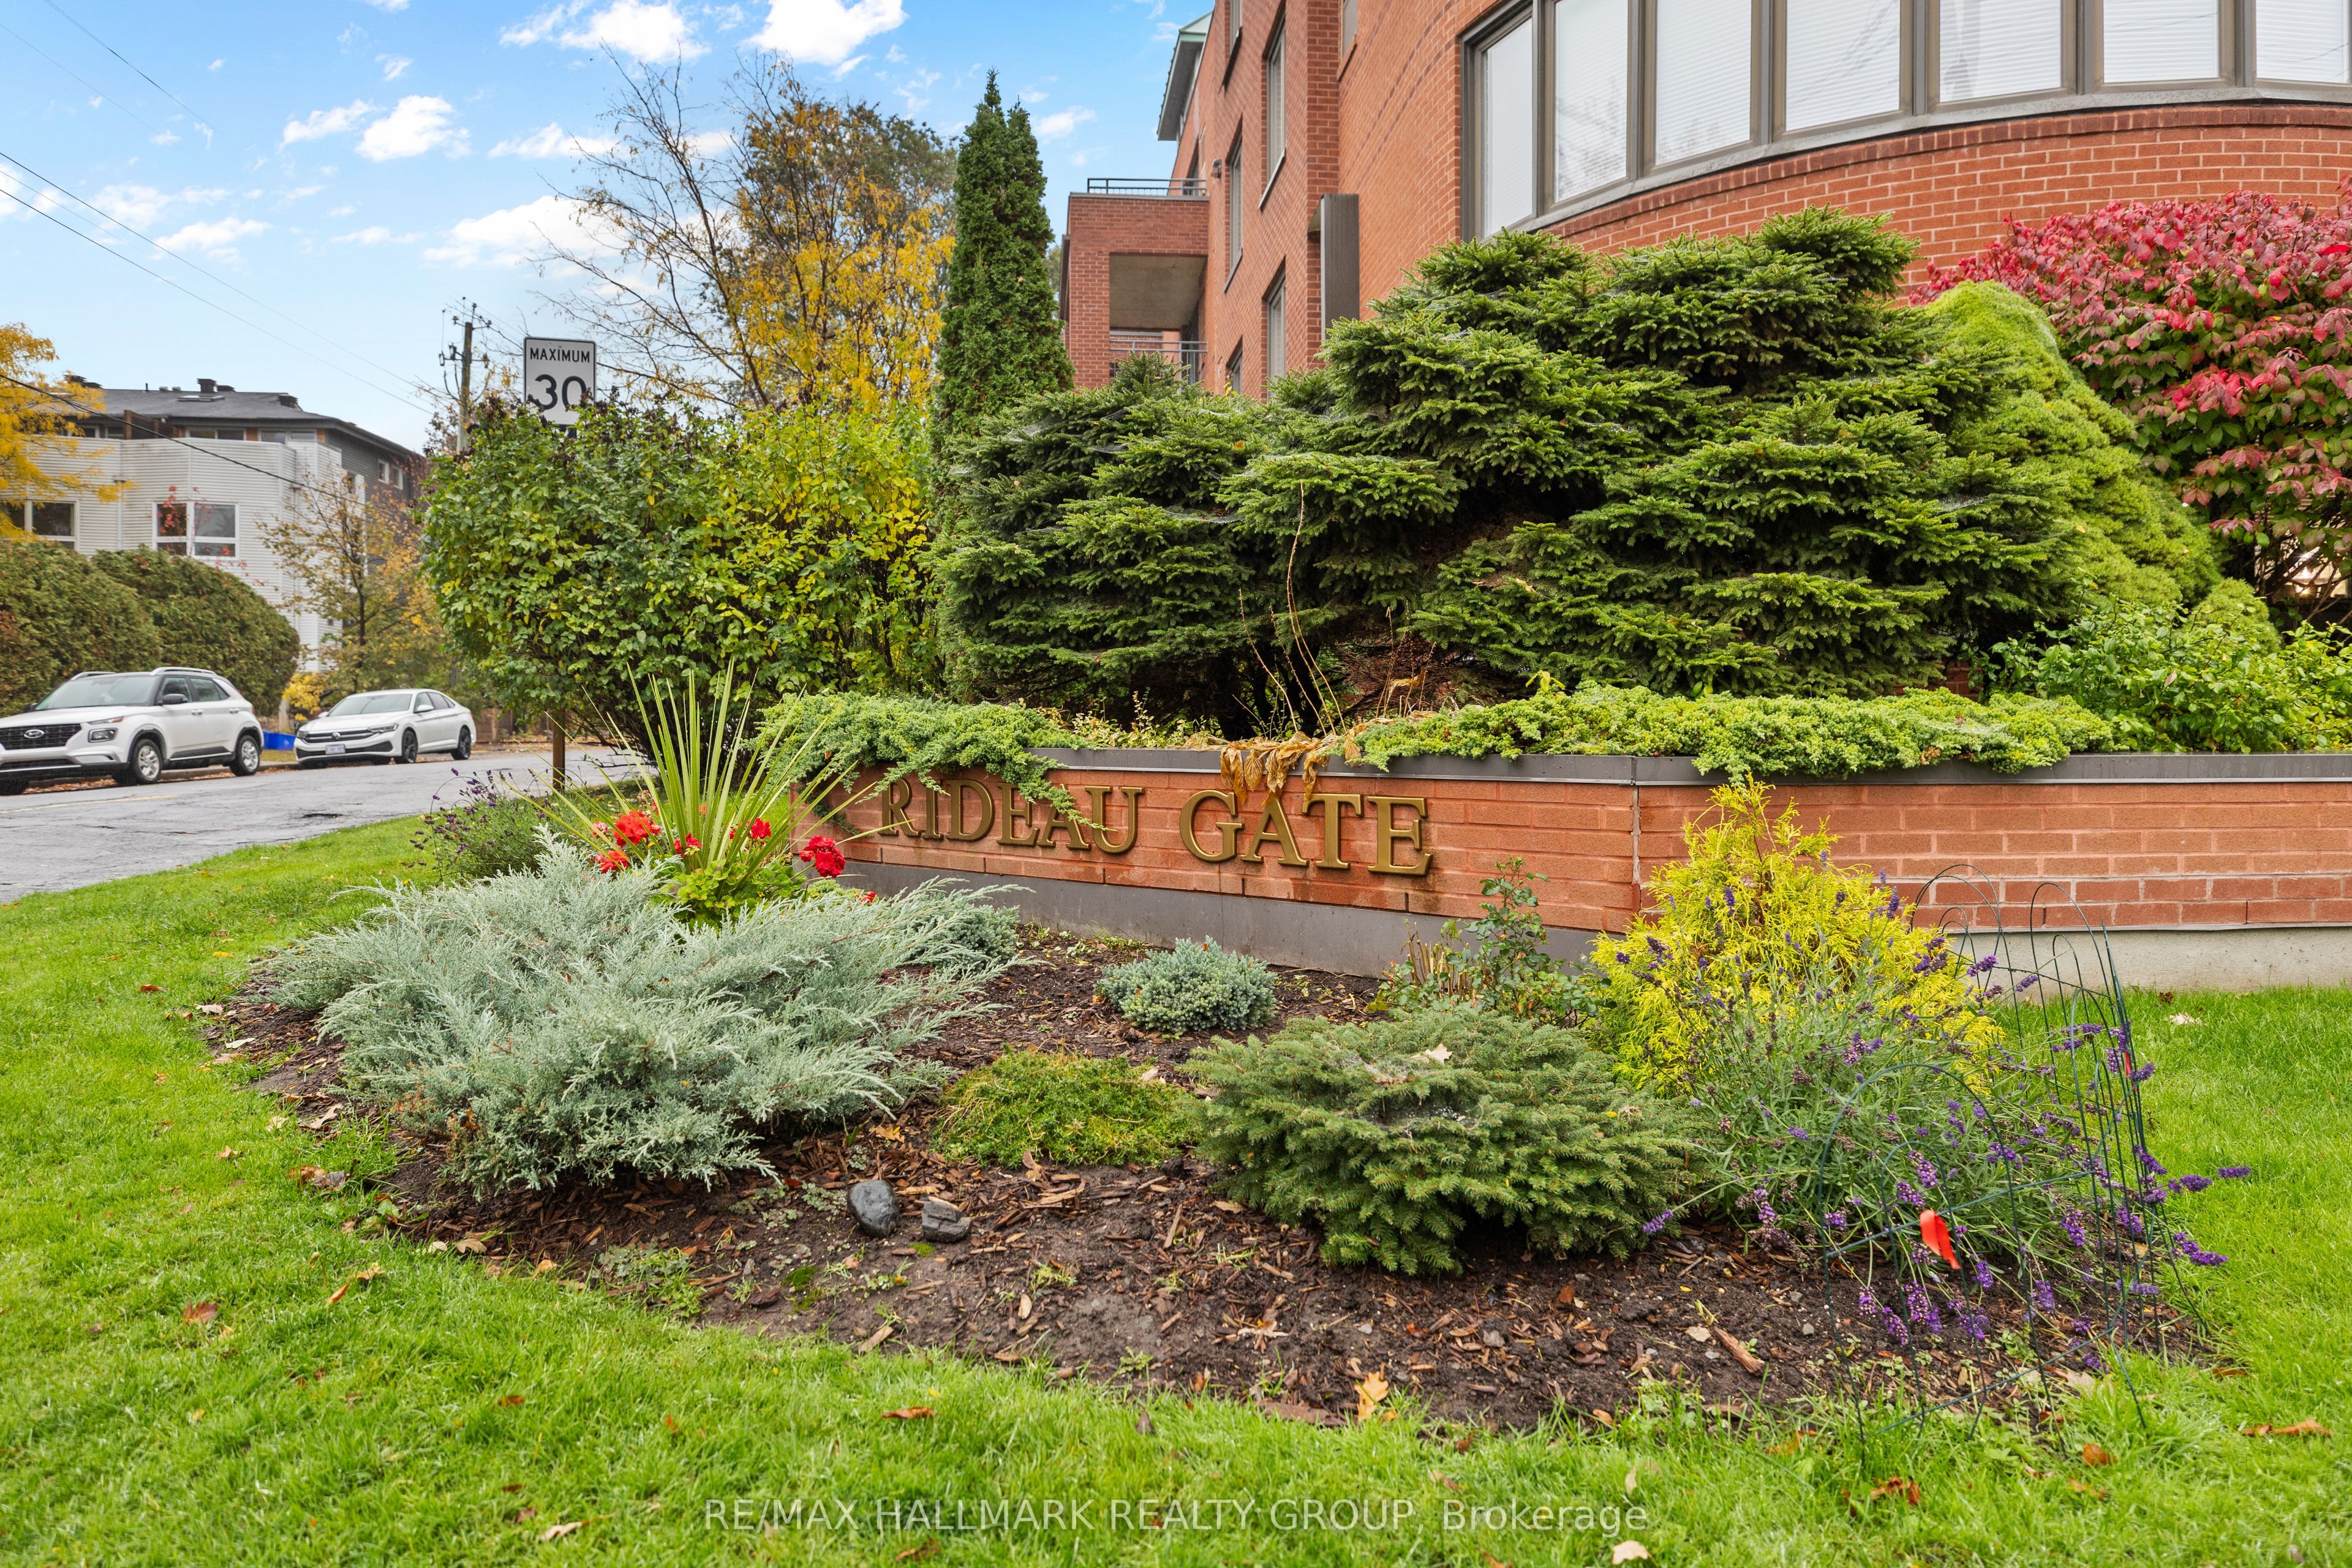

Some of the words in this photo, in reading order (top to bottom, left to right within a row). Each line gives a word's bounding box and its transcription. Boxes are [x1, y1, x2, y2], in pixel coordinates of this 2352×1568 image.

[530, 347, 590, 363] MAXIMUM
[534, 374, 587, 412] 30
[878, 778, 1145, 855] RIDEAU
[1179, 790, 1433, 876] GATE
